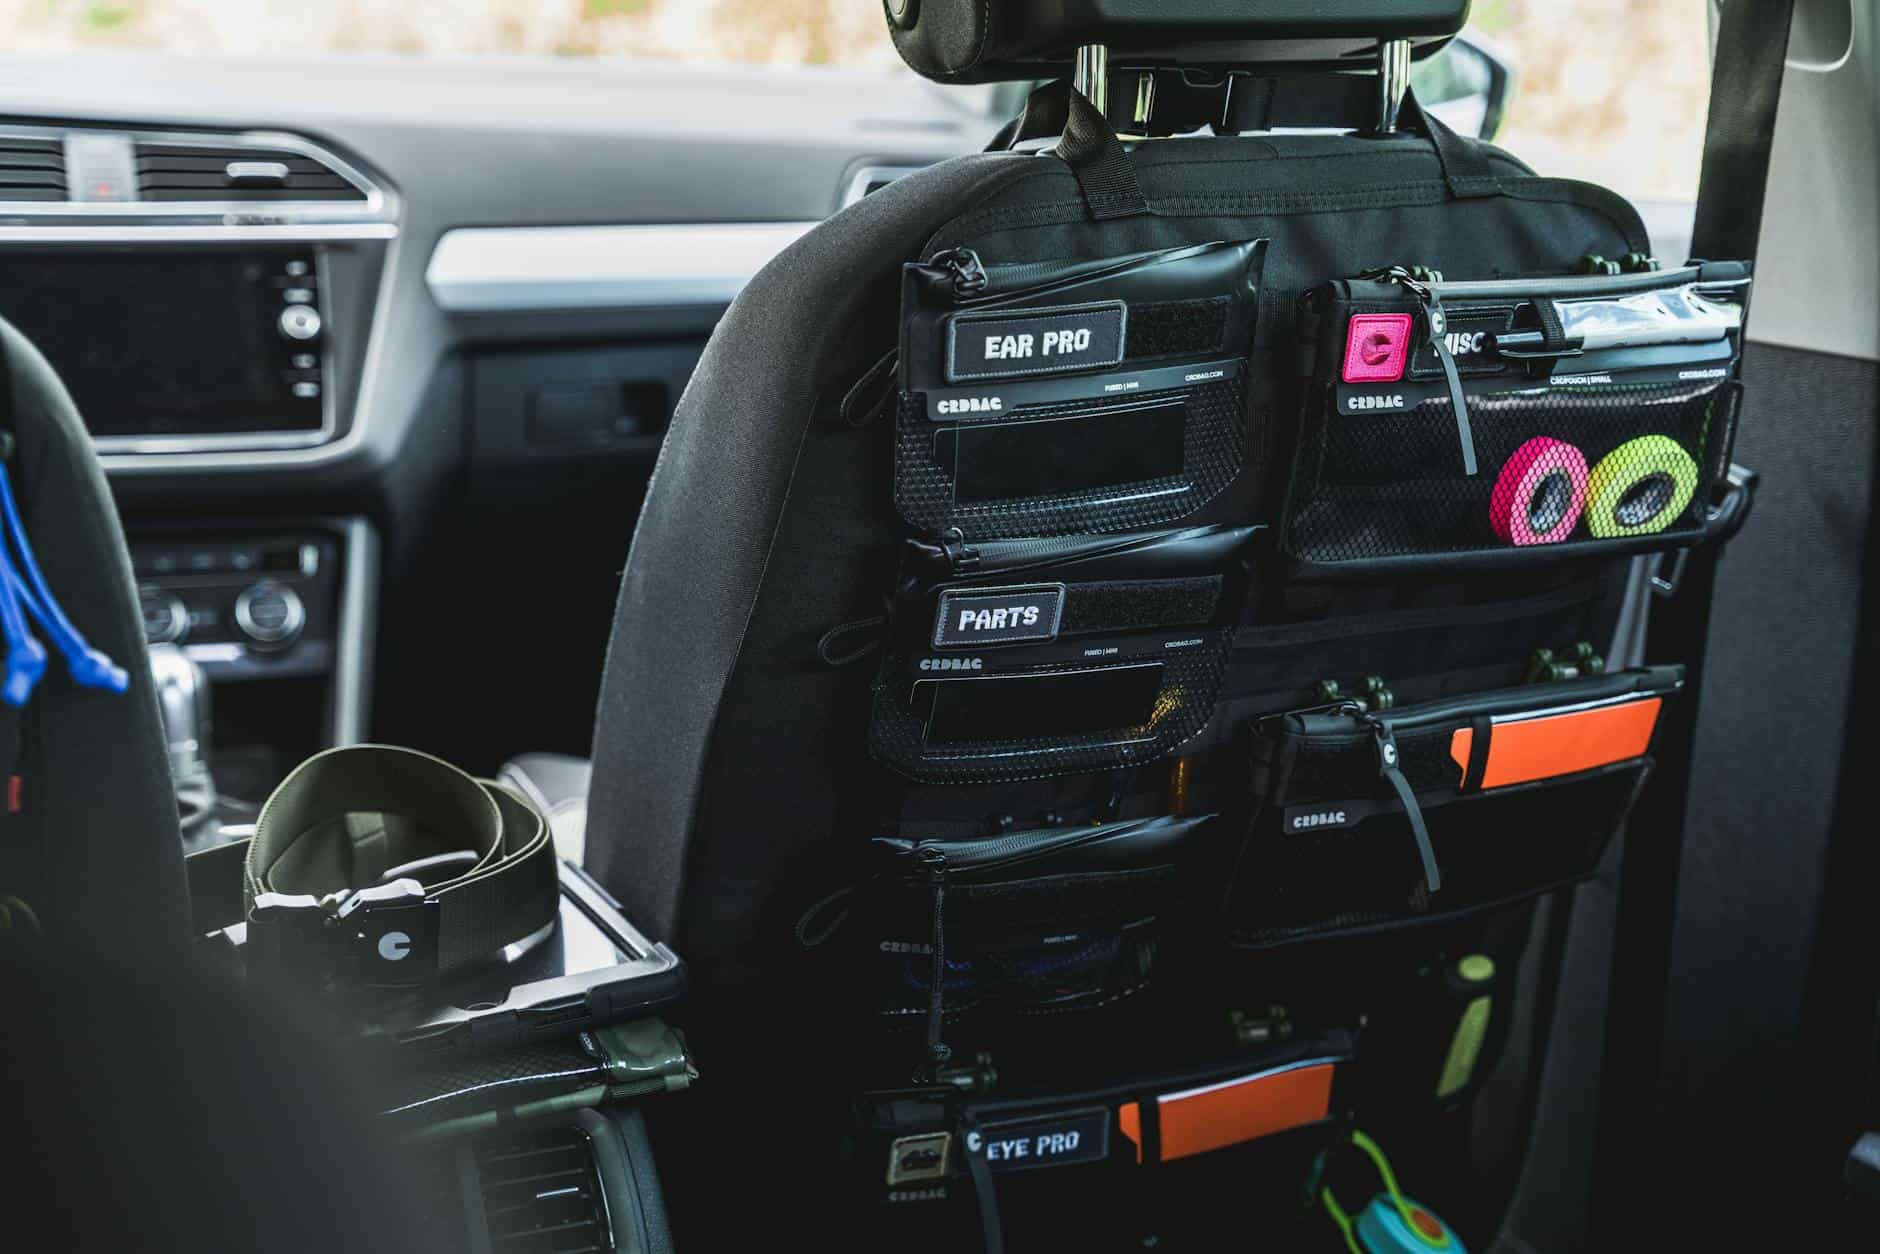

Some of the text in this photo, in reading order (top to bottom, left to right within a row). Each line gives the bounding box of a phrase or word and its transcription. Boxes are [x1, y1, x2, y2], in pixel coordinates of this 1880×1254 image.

[984, 328, 1090, 360] EAR PRO
[958, 606, 1040, 631] PARTS
[880, 941, 934, 955] CRDBA
[987, 1130, 1081, 1161] EYE PRO
